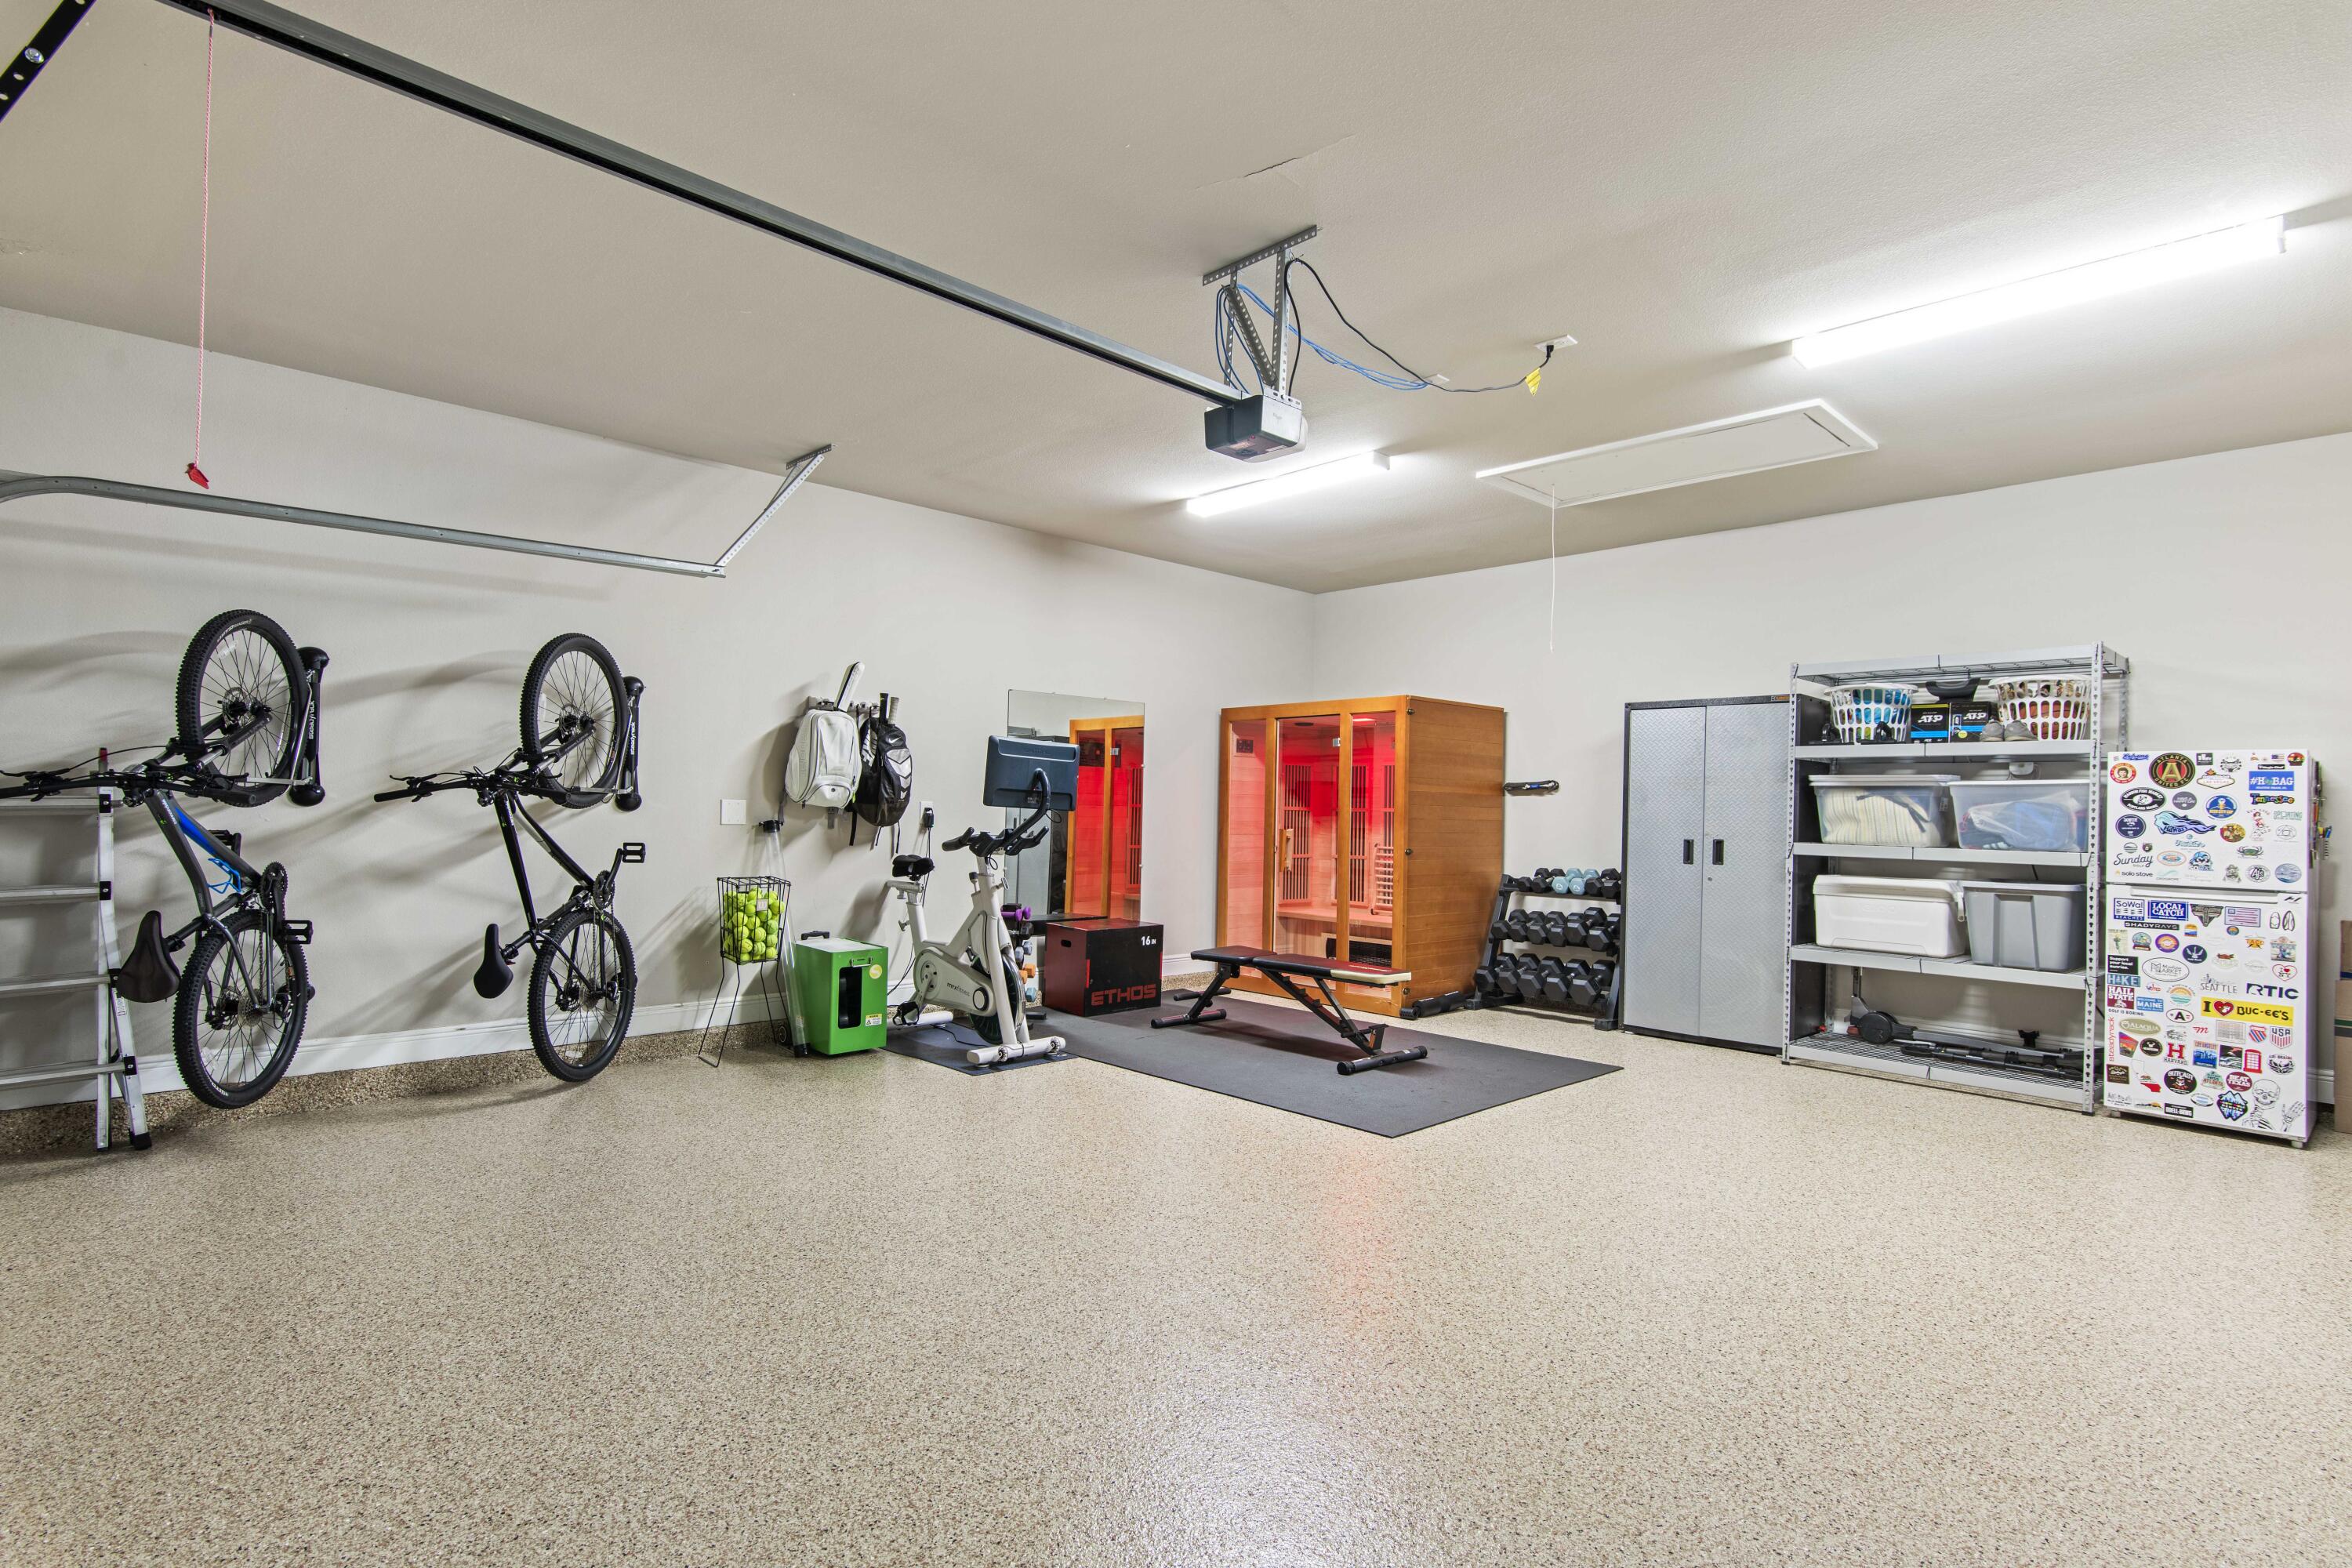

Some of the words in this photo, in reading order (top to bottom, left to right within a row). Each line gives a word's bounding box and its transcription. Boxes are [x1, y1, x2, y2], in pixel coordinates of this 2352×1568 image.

[308, 700, 317, 739] steadyrack
[1918, 714, 1944, 723] ATP
[2157, 754, 2188, 763] ATLANTA
[2154, 778, 2179, 787] UNITED
[2114, 853, 2154, 867] Sunday
[2116, 900, 2143, 909] SoWal
[1141, 935, 1151, 946] 16
[2109, 986, 2133, 995] HAIL
[2199, 982, 2238, 994] SEATTLE
[2246, 982, 2299, 1000] RTIC
[1091, 983, 1156, 1006] ETHOS
[2203, 1001, 2212, 1012] I
[2131, 1021, 2158, 1031] ALAQUA
[2272, 1028, 2291, 1036] USA
[2168, 1043, 2186, 1059] H
[2164, 1057, 2188, 1065] HARVARD
[2227, 1079, 2251, 1087] TEXAS
[2229, 1074, 2249, 1083] BEAT
